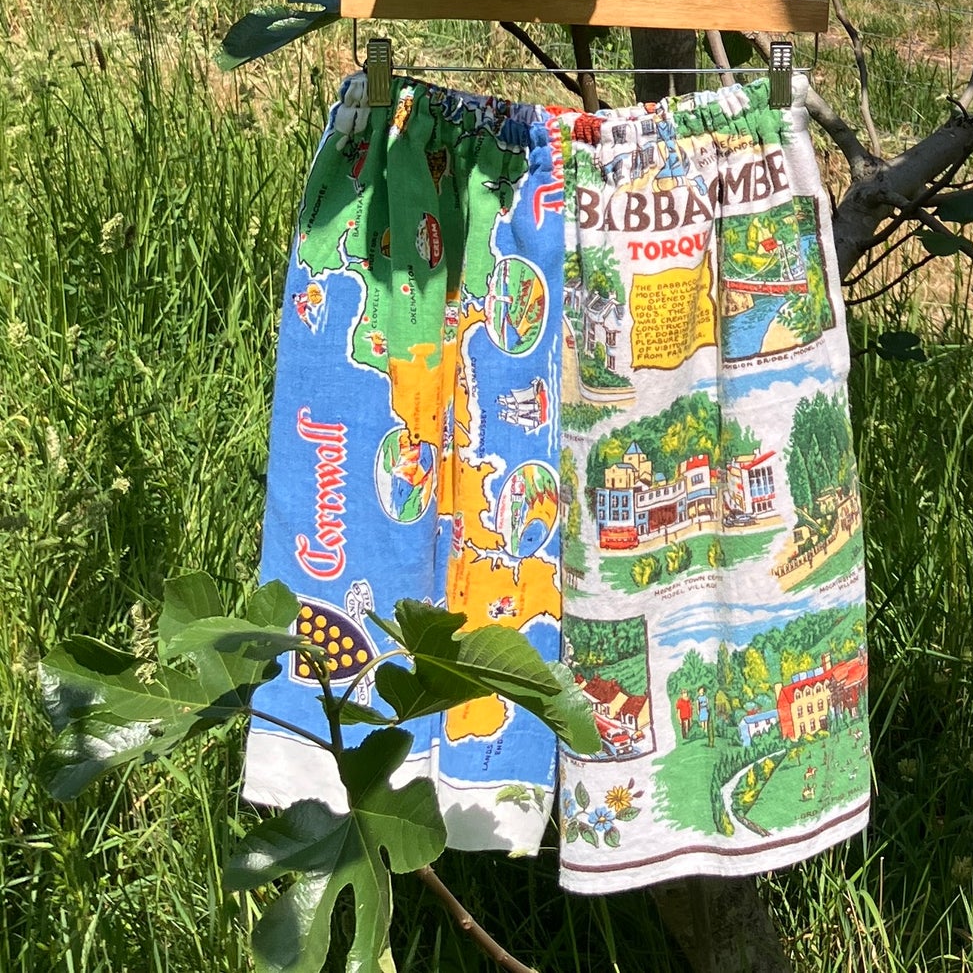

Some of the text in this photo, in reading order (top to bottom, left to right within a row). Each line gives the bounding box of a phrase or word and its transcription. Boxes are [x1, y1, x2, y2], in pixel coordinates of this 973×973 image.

[306, 184, 327, 236] ILFRACOMBE
[431, 223, 440, 258] CREAM
[635, 284, 652, 292] THE
[408, 264, 417, 325] OKEHAMPTON
[635, 291, 667, 299] MODEL
[648, 294, 686, 305] OPENED
[371, 287, 380, 329] CLOVELLY
[635, 303, 668, 312] PUBLIC
[671, 301, 685, 310] ON
[668, 307, 686, 316] THE
[637, 316, 657, 325] WAS
[635, 334, 679, 346] PLEASURE
[639, 345, 652, 353] OF
[636, 353, 663, 361] FROM
[479, 408, 487, 459] MEVAGISSEY
[295, 407, 348, 581] Cornwall
[494, 738, 503, 756] END
[481, 744, 493, 771] LANDS
